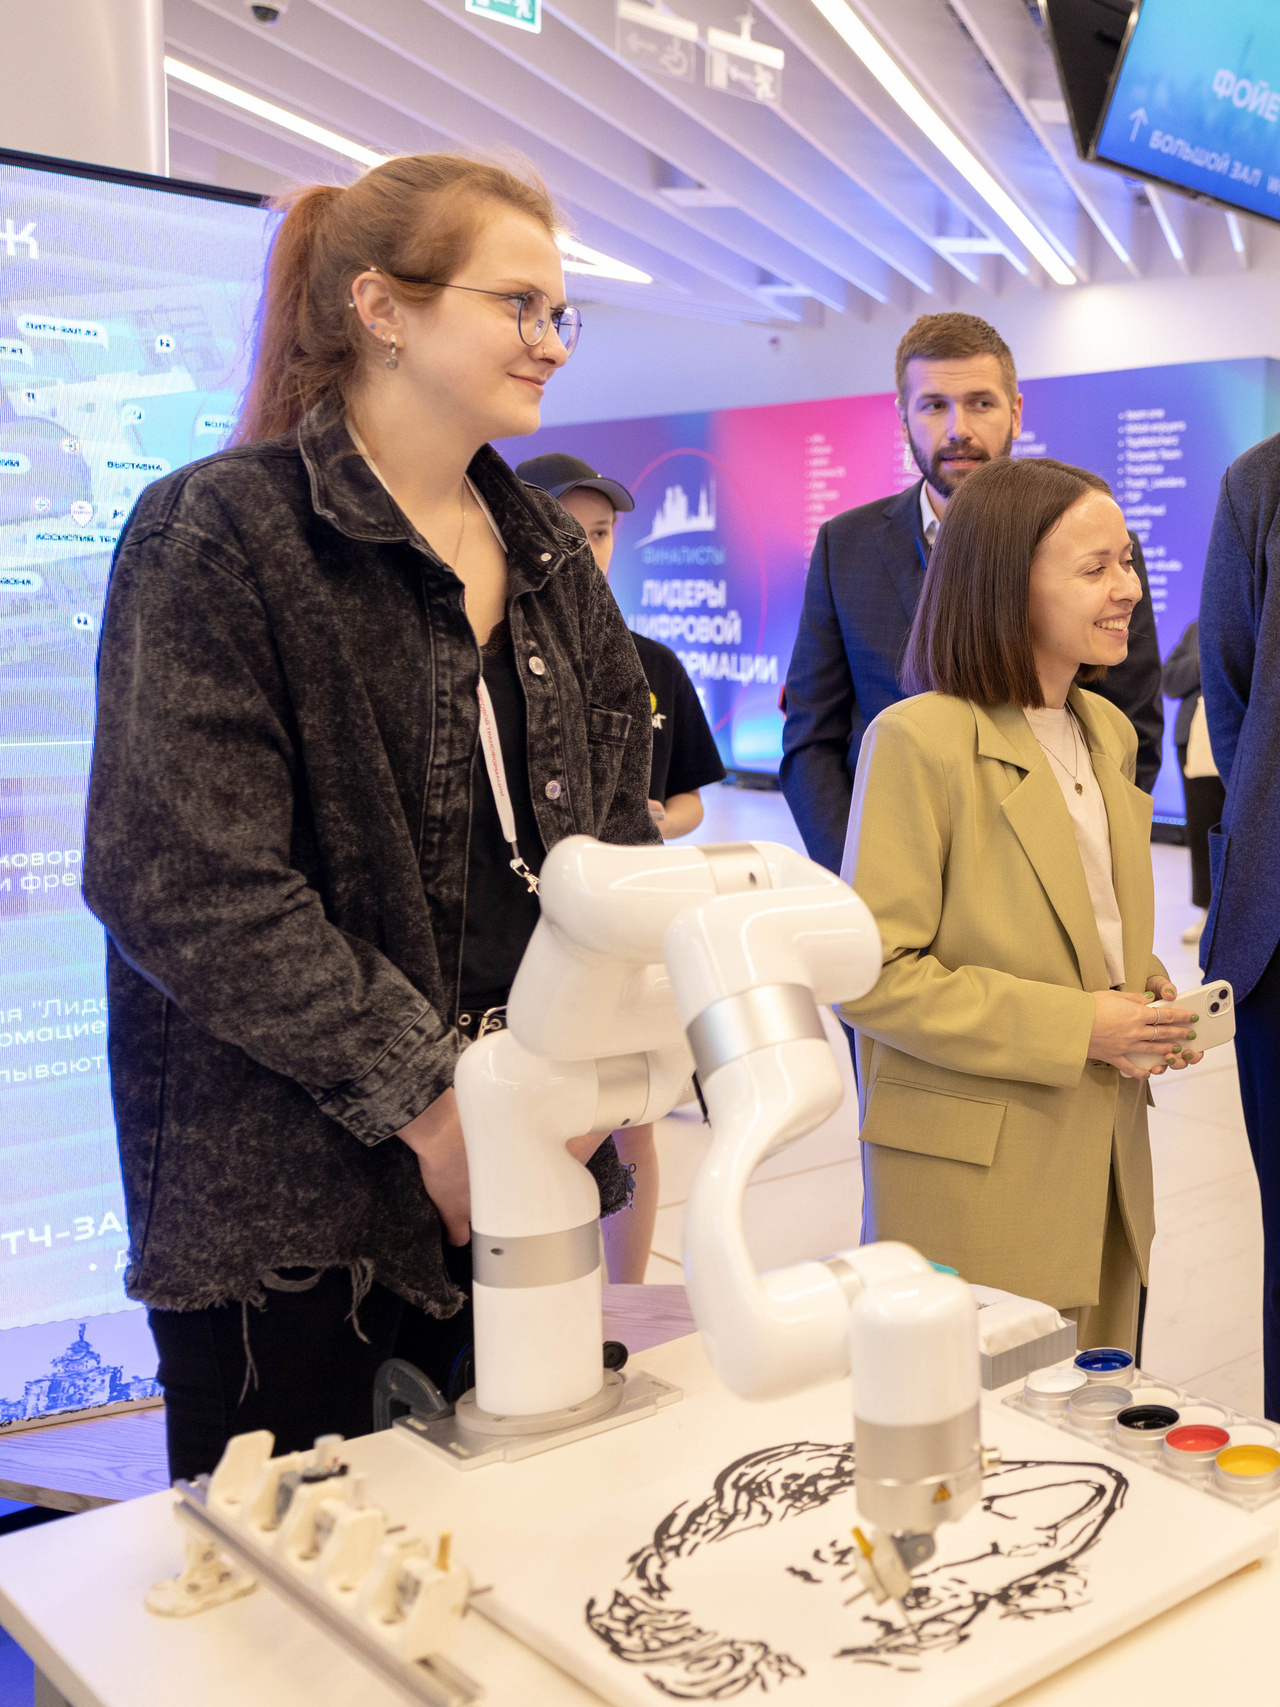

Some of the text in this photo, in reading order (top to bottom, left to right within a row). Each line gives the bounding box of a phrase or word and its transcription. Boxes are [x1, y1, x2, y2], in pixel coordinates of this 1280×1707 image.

[1149, 129, 1262, 187] БОЛЬШОЙ ЗАЛ
[643, 547, 726, 565] ФИНАЛИСТЫ
[641, 579, 727, 612] ЛИДЕРЫ
[21, 872, 82, 894] фре
